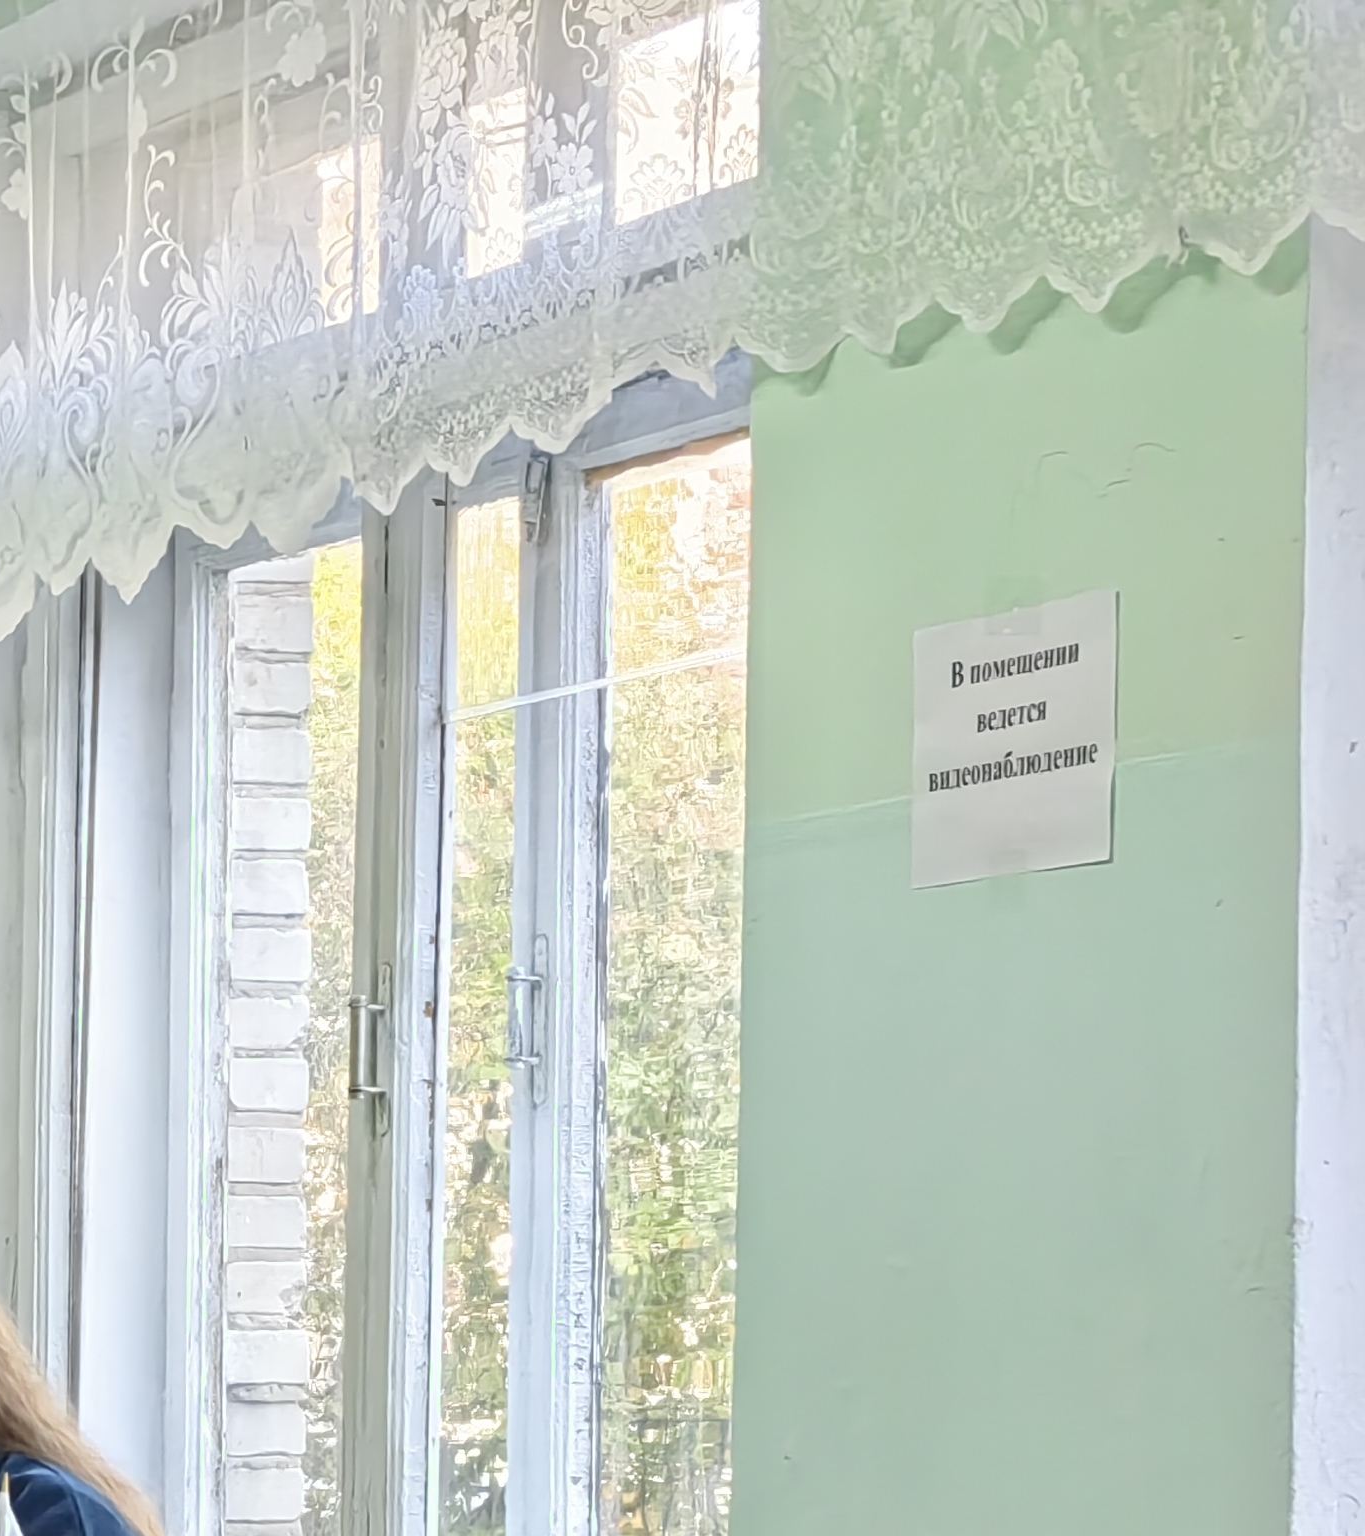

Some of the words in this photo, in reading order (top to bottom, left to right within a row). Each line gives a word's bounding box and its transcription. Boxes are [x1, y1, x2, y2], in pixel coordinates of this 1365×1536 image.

[952, 660, 964, 688] В
[969, 643, 1080, 685] помещении
[976, 700, 1047, 734] ведется
[928, 742, 1099, 793] видеонаблюдение
